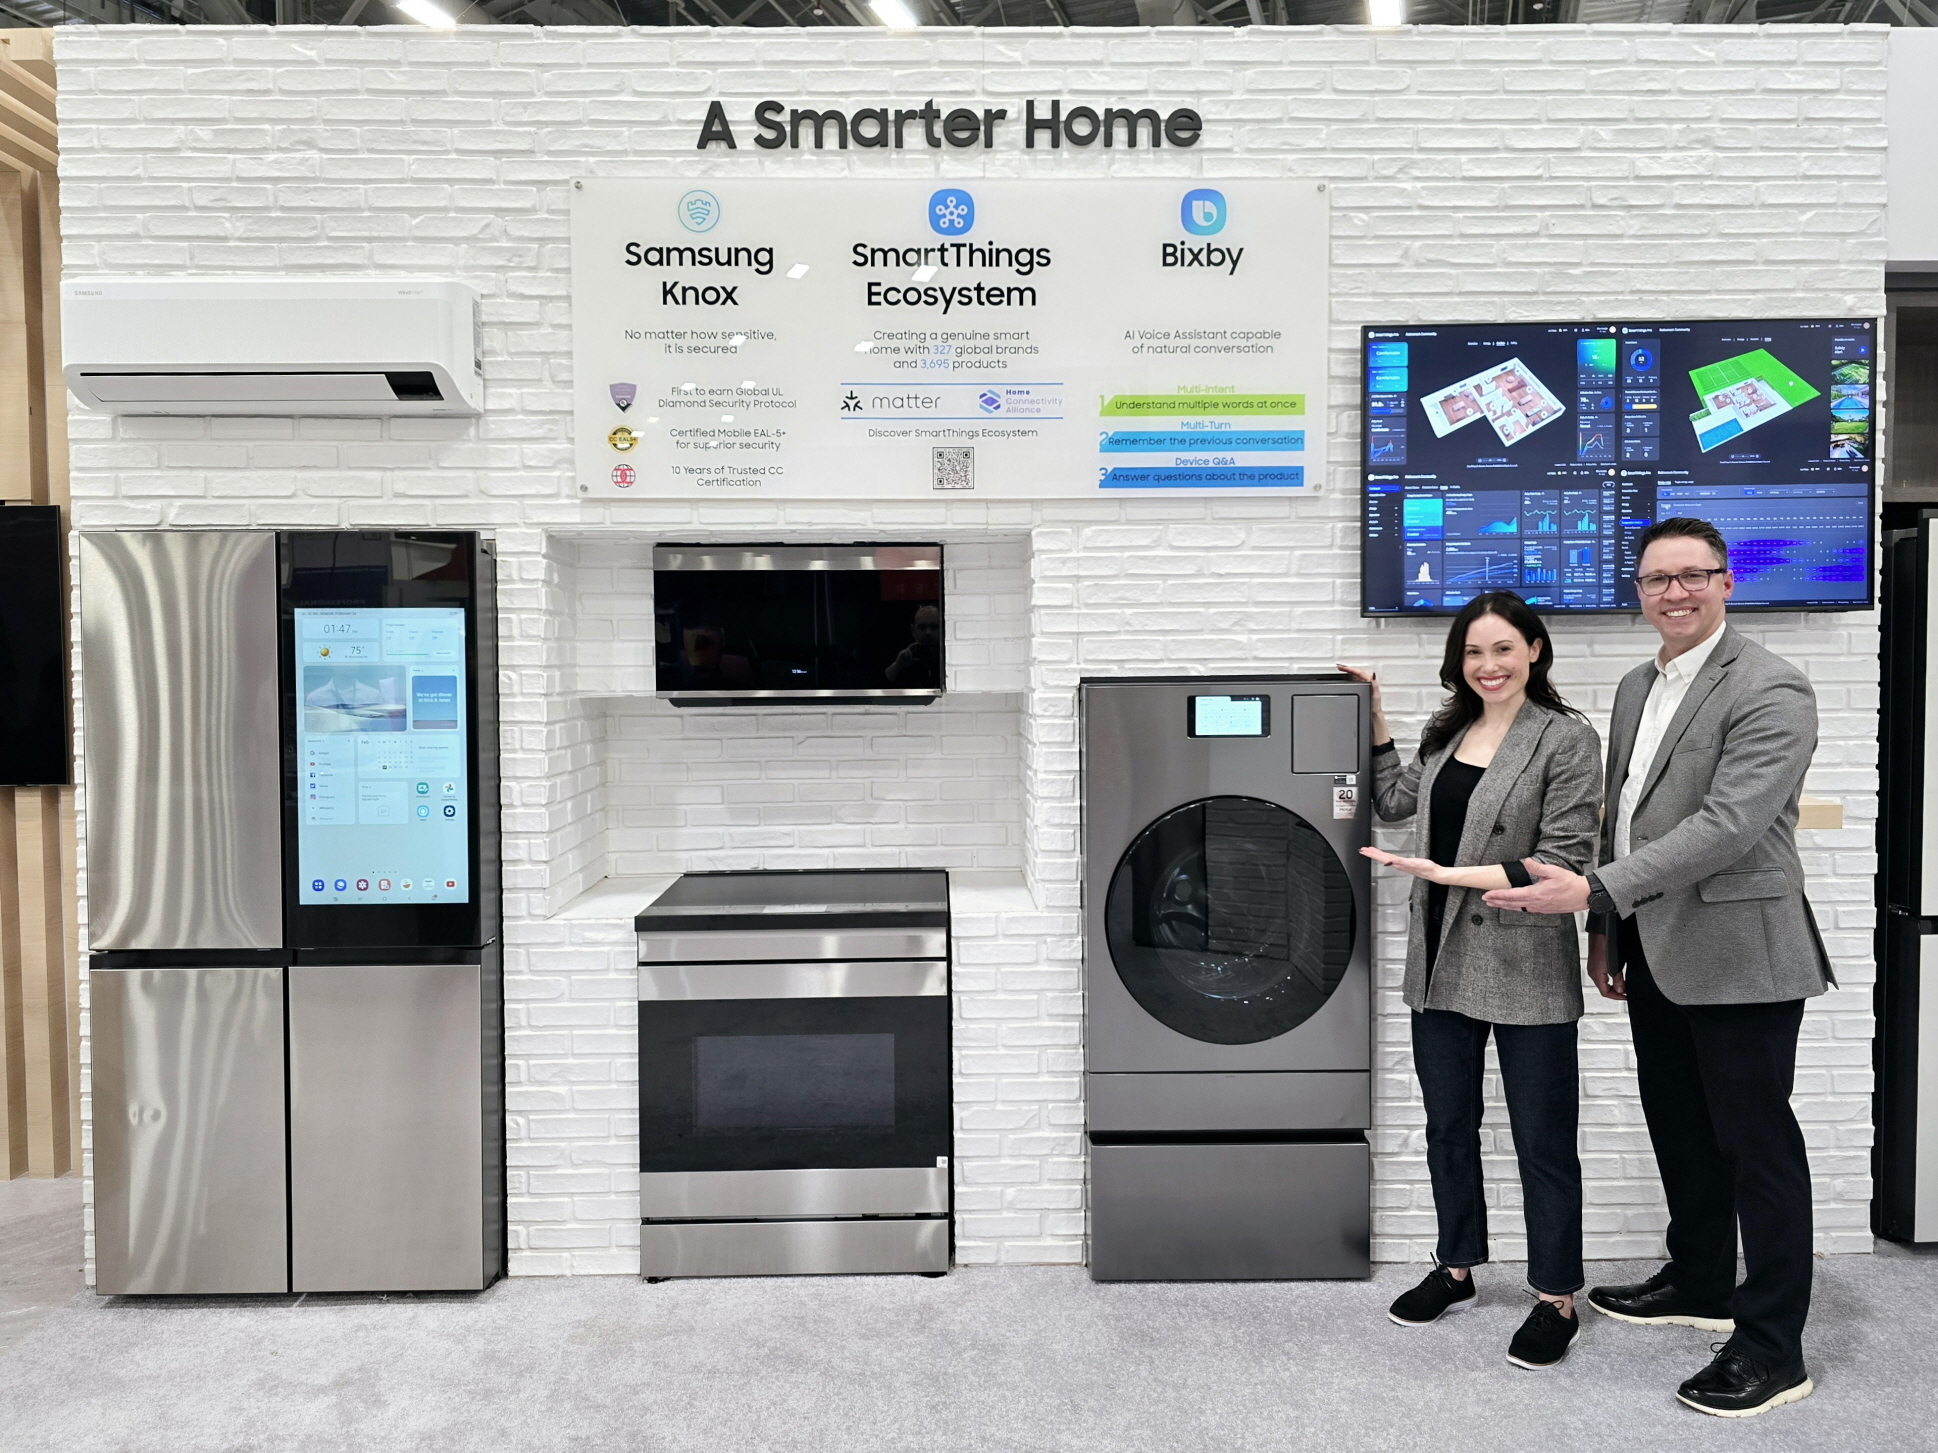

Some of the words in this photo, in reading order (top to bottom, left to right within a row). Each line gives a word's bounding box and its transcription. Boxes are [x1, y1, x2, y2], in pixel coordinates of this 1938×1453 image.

[697, 100, 737, 149] A
[754, 98, 1008, 149] Smarter
[1026, 99, 1202, 148] Home
[625, 242, 774, 275] Samsung
[852, 240, 1051, 276] SmartThings
[1162, 240, 1244, 275] Bixby
[662, 281, 738, 305] Knox
[867, 281, 1036, 315] Ecosystem
[625, 329, 641, 340] No
[645, 329, 687, 340] matter
[691, 329, 718, 340] how
[874, 329, 926, 344] Creating
[930, 332, 938, 341] a
[941, 330, 990, 344] genuine
[993, 330, 1029, 341] smart
[1124, 330, 1135, 340] AI
[1138, 329, 1170, 340] Voice
[1174, 329, 1227, 340] Assistant
[1230, 329, 1281, 343] capable
[664, 343, 672, 354] it
[675, 343, 684, 354] is
[687, 344, 738, 354] secured
[904, 344, 930, 355] with
[933, 344, 953, 355] 327
[955, 344, 993, 358] global
[995, 344, 1039, 355] brands
[1131, 343, 1145, 354] of
[1147, 343, 1190, 354] natural
[1194, 343, 1274, 354] conversation
[893, 358, 917, 369] and
[920, 358, 950, 370] 3,695
[952, 358, 1008, 372] products
[695, 388, 706, 396] to
[735, 387, 770, 396] Global
[772, 387, 783, 397] UL
[1177, 384, 1235, 394] Multi-Intent
[658, 398, 706, 408] Diamond
[709, 398, 751, 411] Security
[754, 399, 797, 409] Protocol
[872, 393, 941, 409] matter
[1005, 397, 1063, 407] Connectivity
[1115, 400, 1176, 410] Understand
[1178, 400, 1219, 412] multiple
[1222, 400, 1254, 409] words
[1257, 400, 1268, 409] at
[1270, 401, 1297, 409] once
[1005, 405, 1041, 414] Alliance
[1180, 420, 1231, 430] Multi-Turn
[670, 427, 716, 438] Certified
[718, 428, 752, 438] Mobile
[754, 428, 786, 438] EAL-5+
[868, 428, 913, 438] Discover
[915, 428, 980, 440] SmartThings
[982, 428, 1039, 440] Ecosystem
[675, 439, 691, 449] for
[738, 439, 781, 452] security
[1108, 436, 1167, 446] Remember
[1170, 436, 1186, 446] the
[1189, 436, 1233, 448] previous
[1235, 435, 1304, 445] conversation
[1175, 456, 1210, 467] Device
[1212, 456, 1236, 467] Q&A
[671, 465, 681, 475] 10
[683, 465, 712, 475] Years
[714, 465, 725, 475] of
[727, 465, 766, 475] Trusted
[768, 466, 784, 475] CC
[696, 477, 762, 487] Certification
[1111, 472, 1151, 482] Answer
[1153, 471, 1203, 484] questions
[1205, 471, 1236, 482] about
[1239, 471, 1256, 481] the
[1258, 471, 1300, 484] product
[323, 624, 351, 634] 01:47
[1338, 789, 1353, 800] 20
